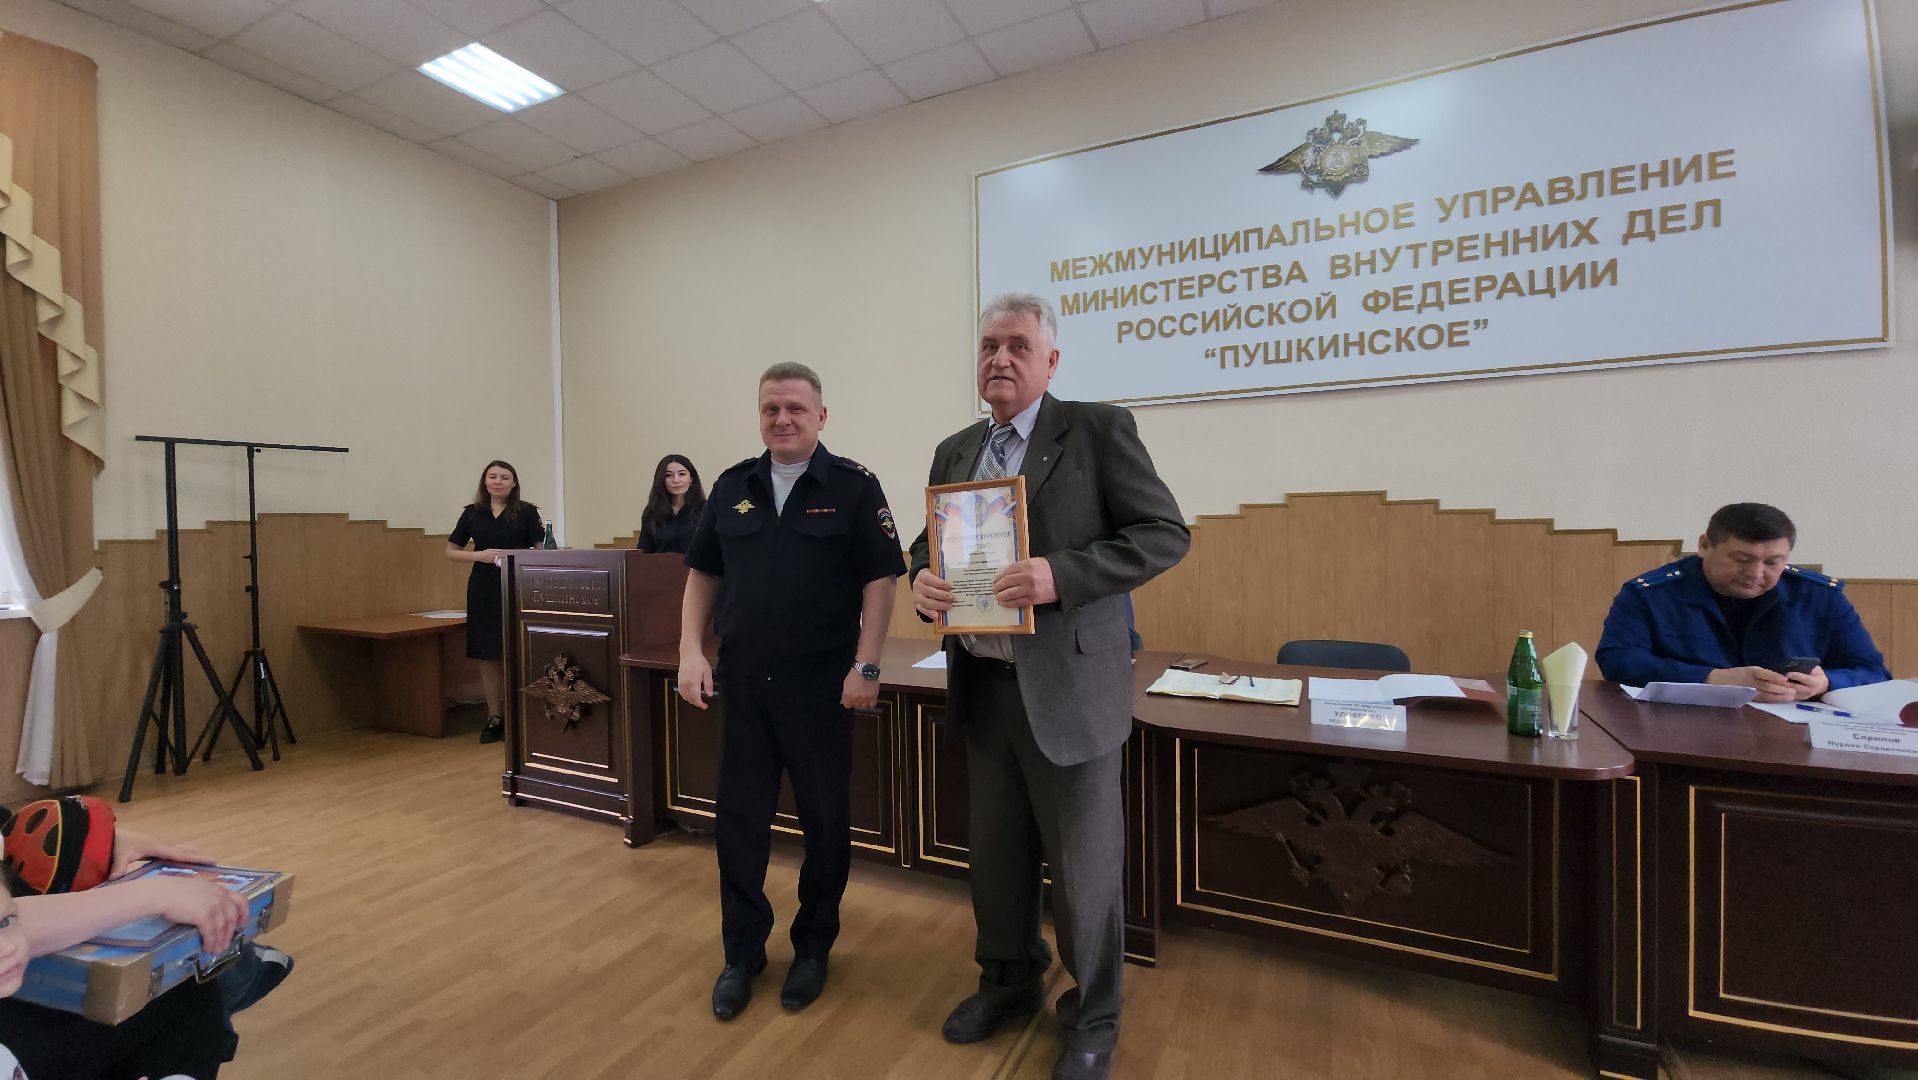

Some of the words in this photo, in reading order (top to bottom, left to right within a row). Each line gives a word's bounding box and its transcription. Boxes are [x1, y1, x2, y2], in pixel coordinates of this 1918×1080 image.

[1050, 201, 1416, 283] МЕЖМУНИЦИПАЛЬНОЕ
[1436, 148, 1737, 223] УПРАВЛЕНИЕ
[1060, 260, 1309, 317] МИНИСТЕРСТВА
[1330, 216, 1600, 280] ВНУТРЕННИХ
[1621, 198, 1722, 246] ДЕЛ
[1117, 291, 1337, 344] РОССИЙСКОЙ
[1362, 257, 1618, 314] ФЕДЕРАЦИИ
